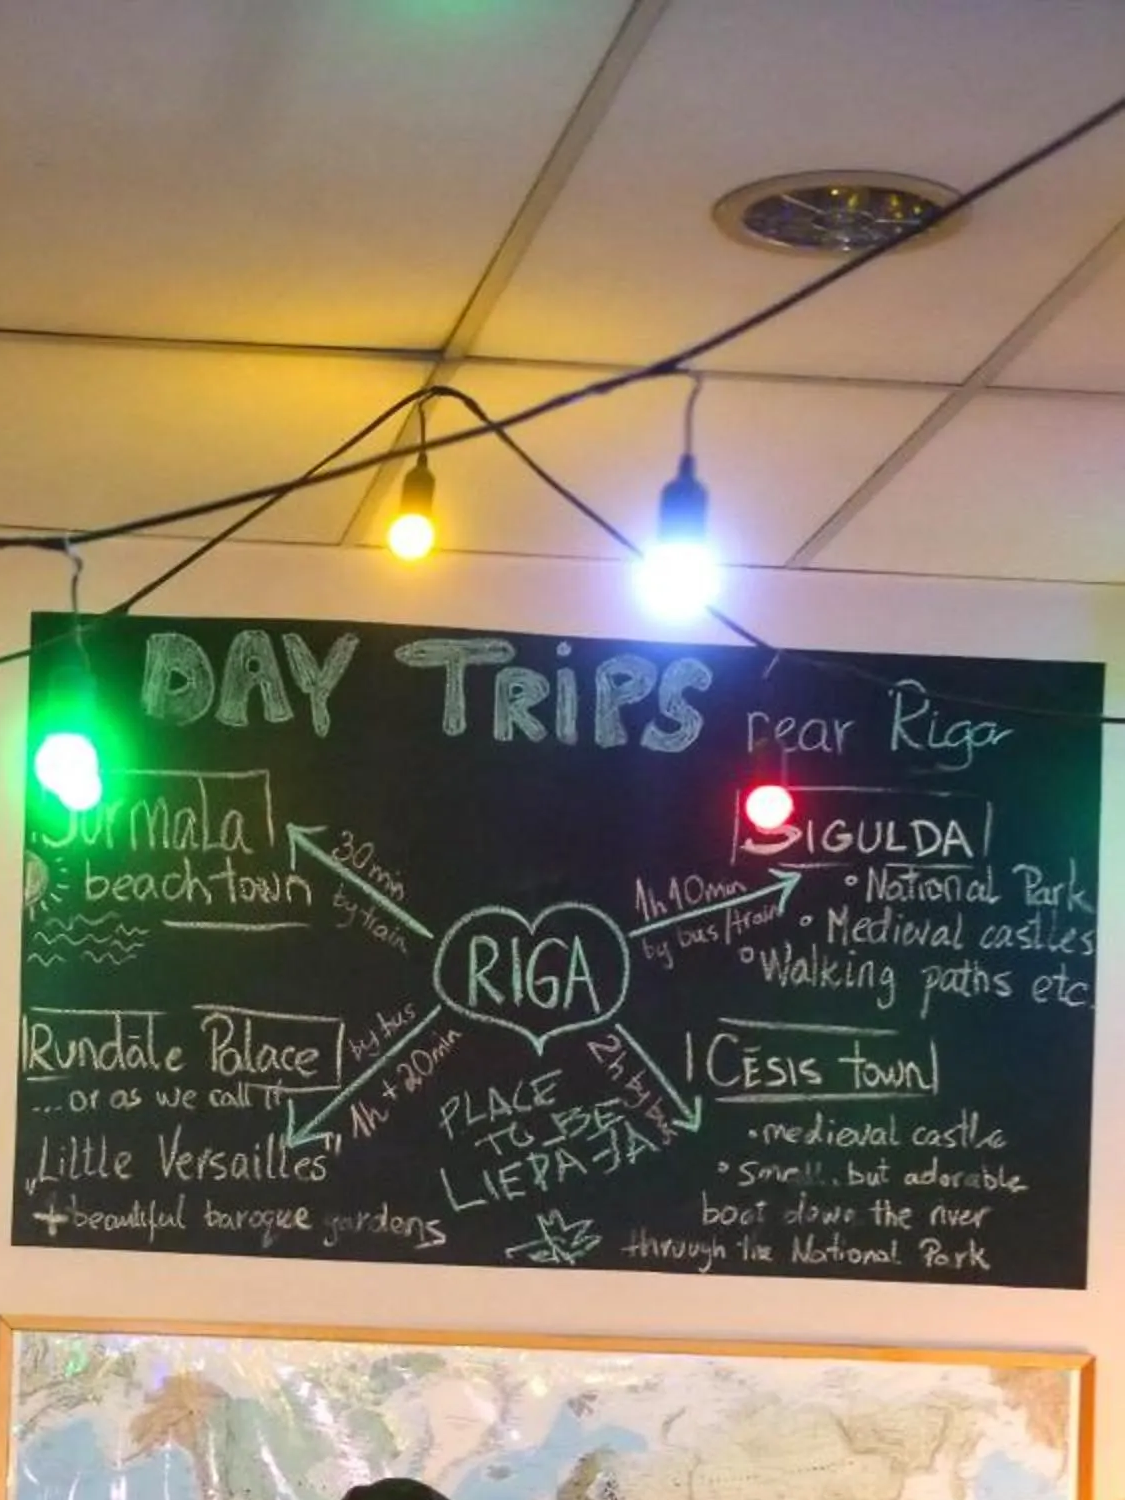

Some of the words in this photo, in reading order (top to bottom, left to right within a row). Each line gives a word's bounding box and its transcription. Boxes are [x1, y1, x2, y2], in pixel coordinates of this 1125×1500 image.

[141, 629, 360, 738] DAY
[864, 862, 1002, 905] National
[1011, 857, 1096, 913] Park
[642, 935, 675, 970] by
[979, 906, 1096, 956] castles
[467, 934, 601, 1015] RIGA
[760, 940, 897, 1010] Walking
[920, 957, 1013, 1020] paths
[200, 1011, 321, 1078] Palace
[838, 1039, 933, 1090] town
[109, 1087, 142, 1110] as
[156, 1087, 198, 1110] we
[210, 1081, 250, 1109] call
[439, 1068, 564, 1141] PLACE
[549, 1097, 626, 1141] BE
[474, 1120, 535, 1156] TO
[762, 1110, 901, 1148] medieval
[847, 1157, 891, 1187] but
[903, 1156, 1030, 1194] adorable
[205, 1199, 313, 1249] baroque
[867, 1198, 913, 1230] the
[929, 1202, 994, 1230] river
[790, 1231, 902, 1266] National
[918, 1235, 993, 1271] Park
